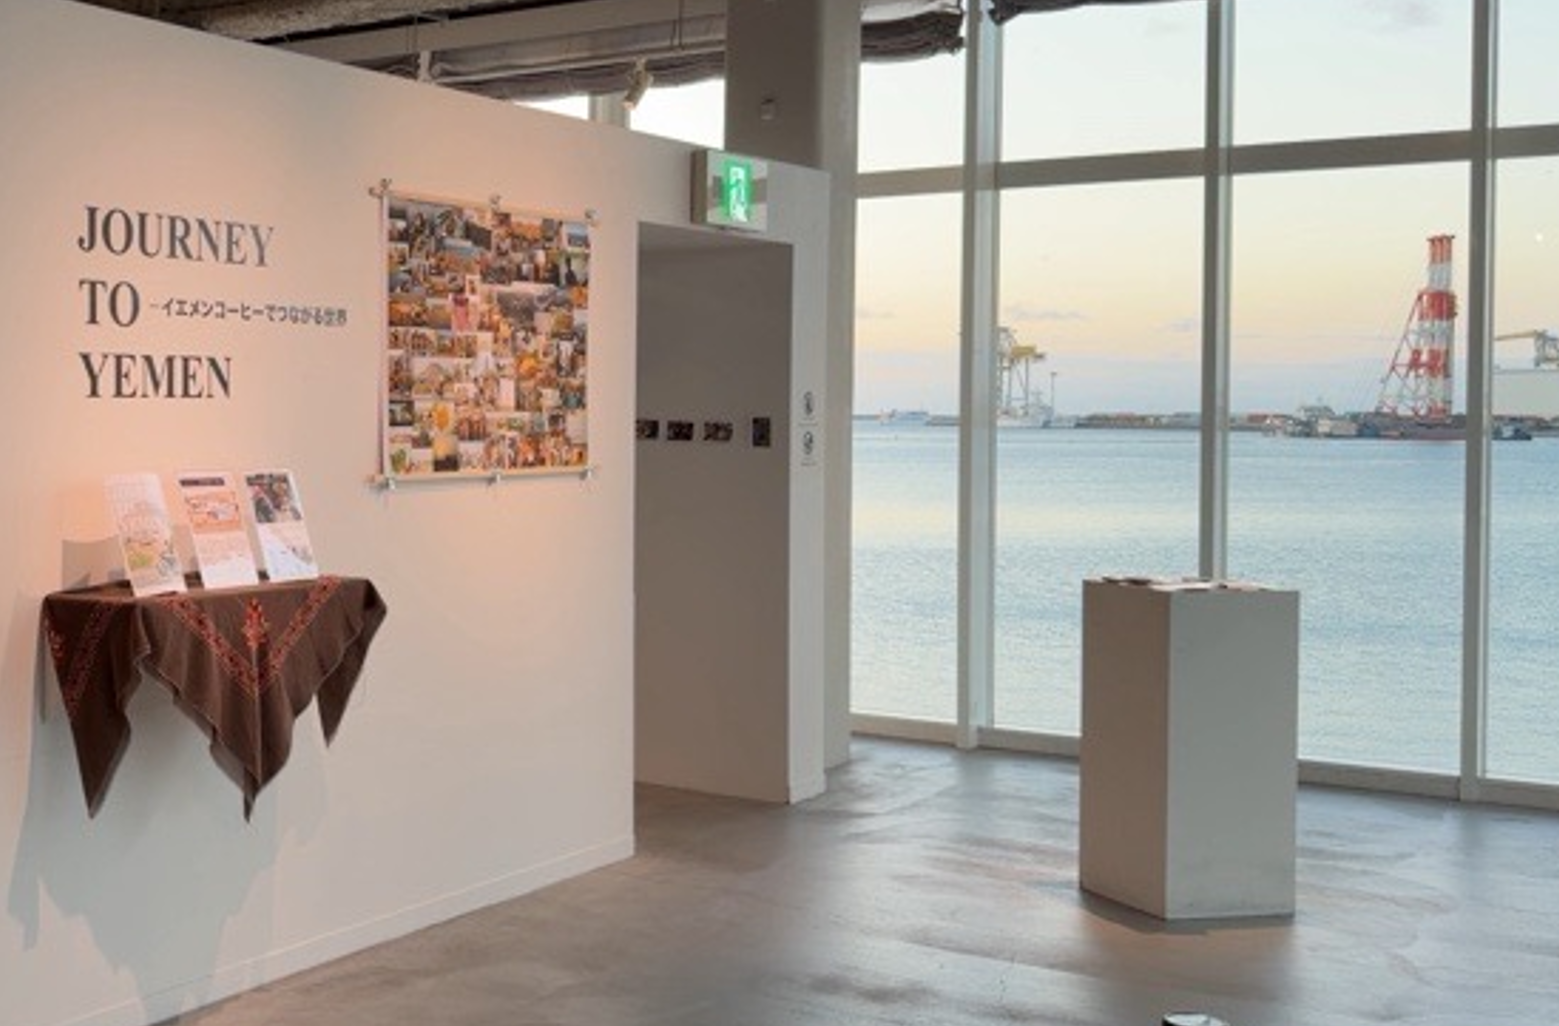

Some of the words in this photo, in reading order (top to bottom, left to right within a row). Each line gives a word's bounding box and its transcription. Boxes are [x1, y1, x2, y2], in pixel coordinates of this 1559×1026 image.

[78, 205, 274, 267] JOURNEY
[78, 279, 140, 328] TO
[78, 352, 233, 399] YEMEN
